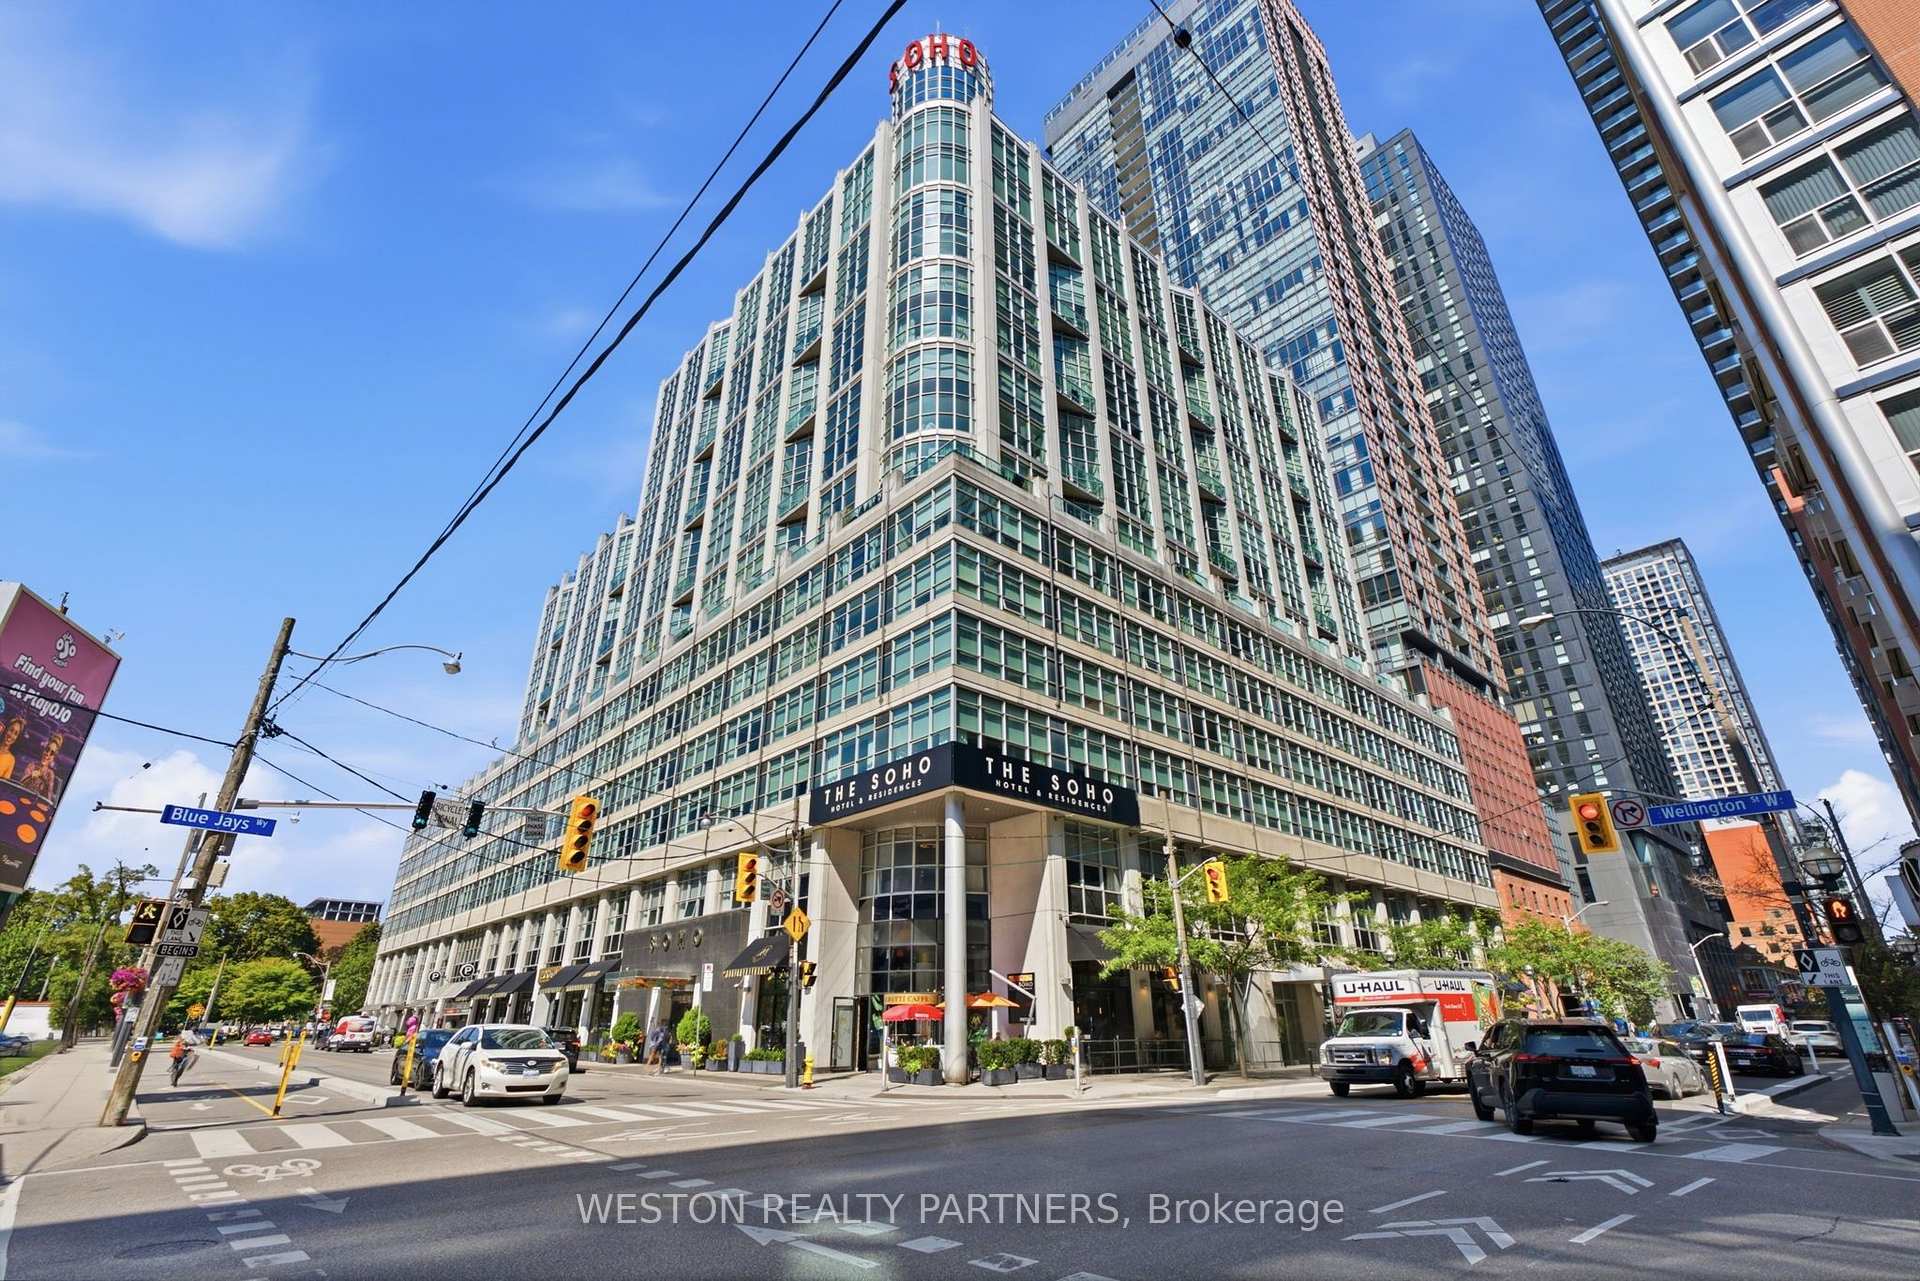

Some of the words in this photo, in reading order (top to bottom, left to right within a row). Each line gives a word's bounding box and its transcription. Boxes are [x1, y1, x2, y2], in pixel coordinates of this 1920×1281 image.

[15, 653, 45, 680] Find
[38, 671, 69, 695] your
[63, 684, 85, 705] fun
[22, 688, 73, 724] PlayOJO
[824, 781, 856, 805] THE
[871, 756, 931, 790] SOHO
[985, 757, 1030, 784] THE
[1051, 774, 1113, 804] SOHO
[435, 801, 463, 815] BICYCLE
[830, 801, 854, 813] HOTEL
[868, 779, 922, 801] RESIDENCES
[995, 780, 1029, 794] HOTEL
[1048, 792, 1107, 813] RESIDENCES
[1661, 800, 1747, 819] Wellington
[1763, 795, 1778, 807] W
[170, 807, 209, 825] Blue
[214, 814, 250, 831] Jays
[161, 945, 195, 956] BEGINS
[1343, 980, 1405, 994] U-HAUL
[1433, 980, 1466, 991] U-HAUL
